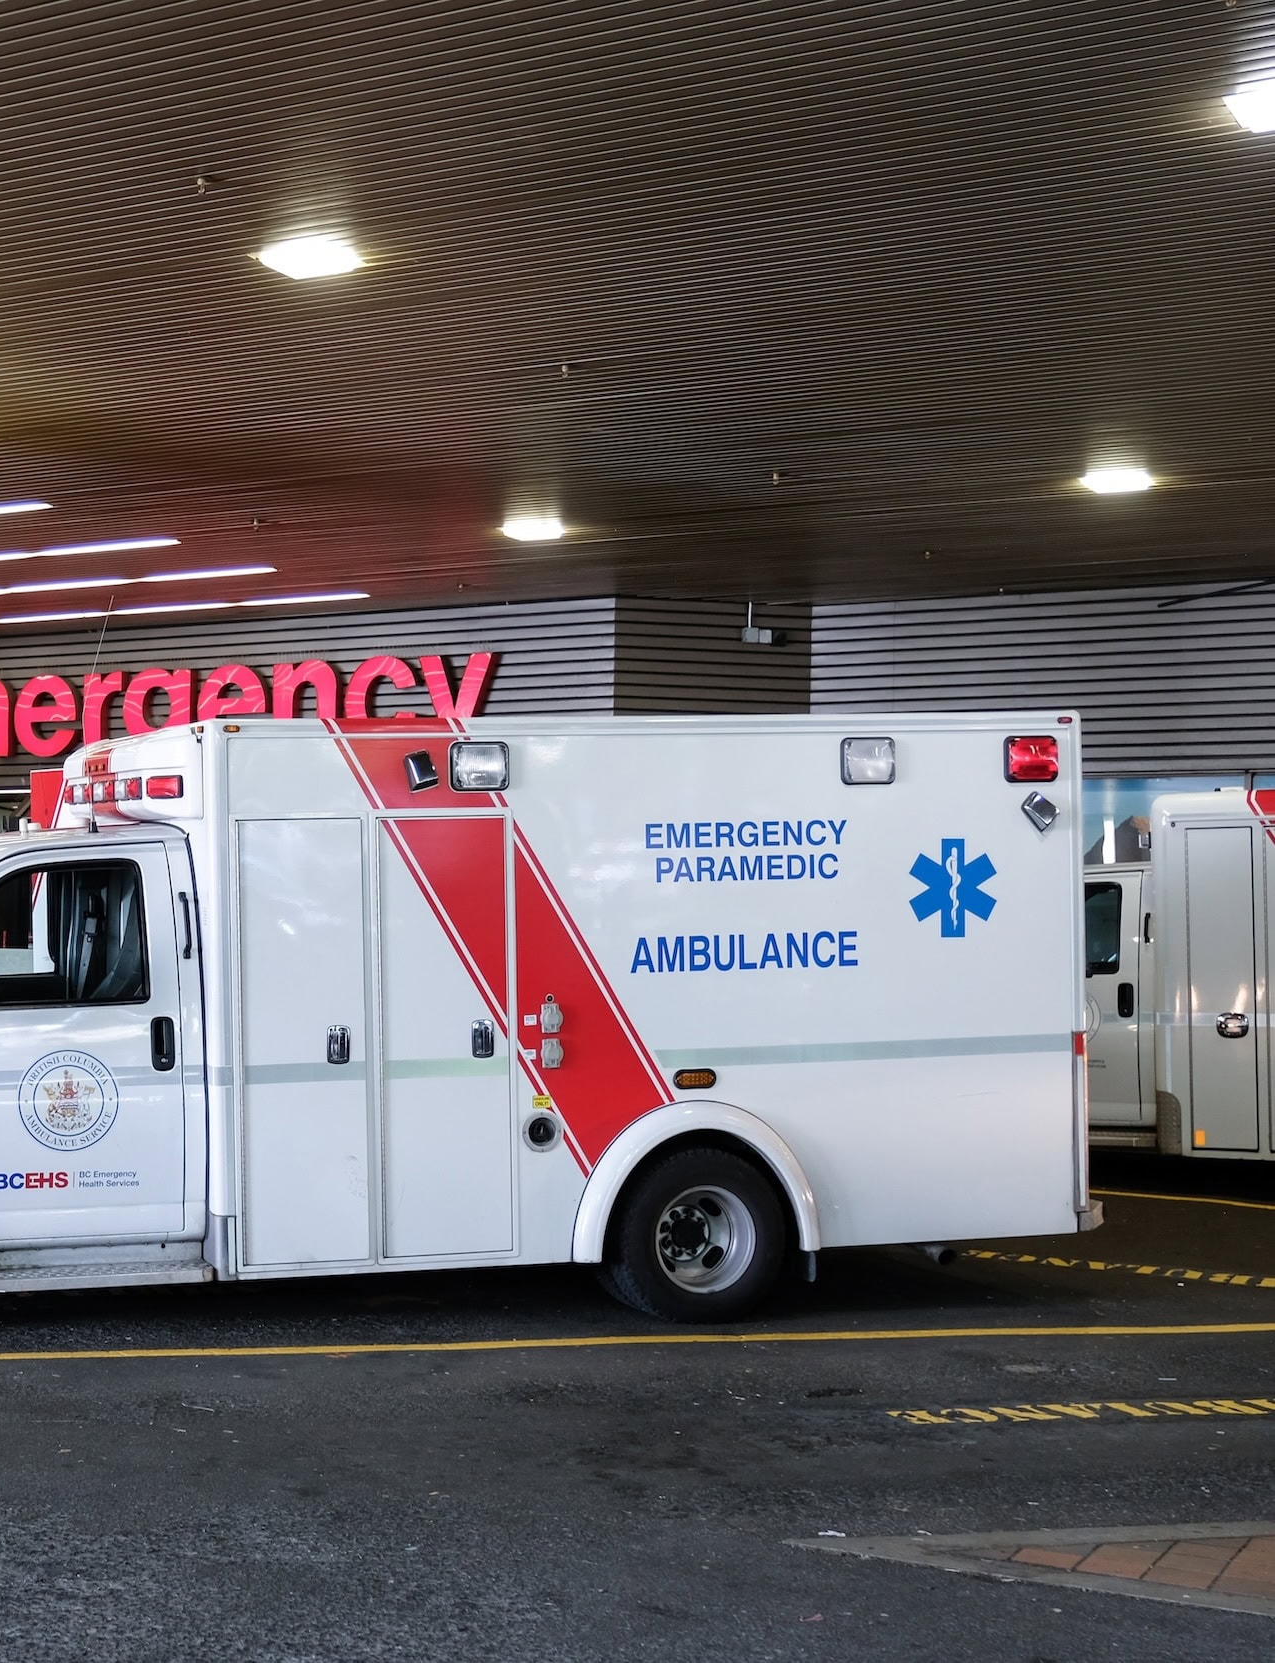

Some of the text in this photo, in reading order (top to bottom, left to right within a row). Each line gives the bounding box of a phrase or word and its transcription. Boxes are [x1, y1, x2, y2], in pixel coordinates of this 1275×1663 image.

[645, 819, 847, 849] EMERGENCY
[656, 853, 839, 883] PARAMEDIC
[630, 930, 859, 974] AMBULANCE
[28, 1054, 110, 1087] BRITISH COLUMBIA
[25, 1111, 114, 1148] AMBULANCE SERVICE
[79, 1179, 140, 1188] Health Services
[93, 1170, 137, 1180] Emergency
